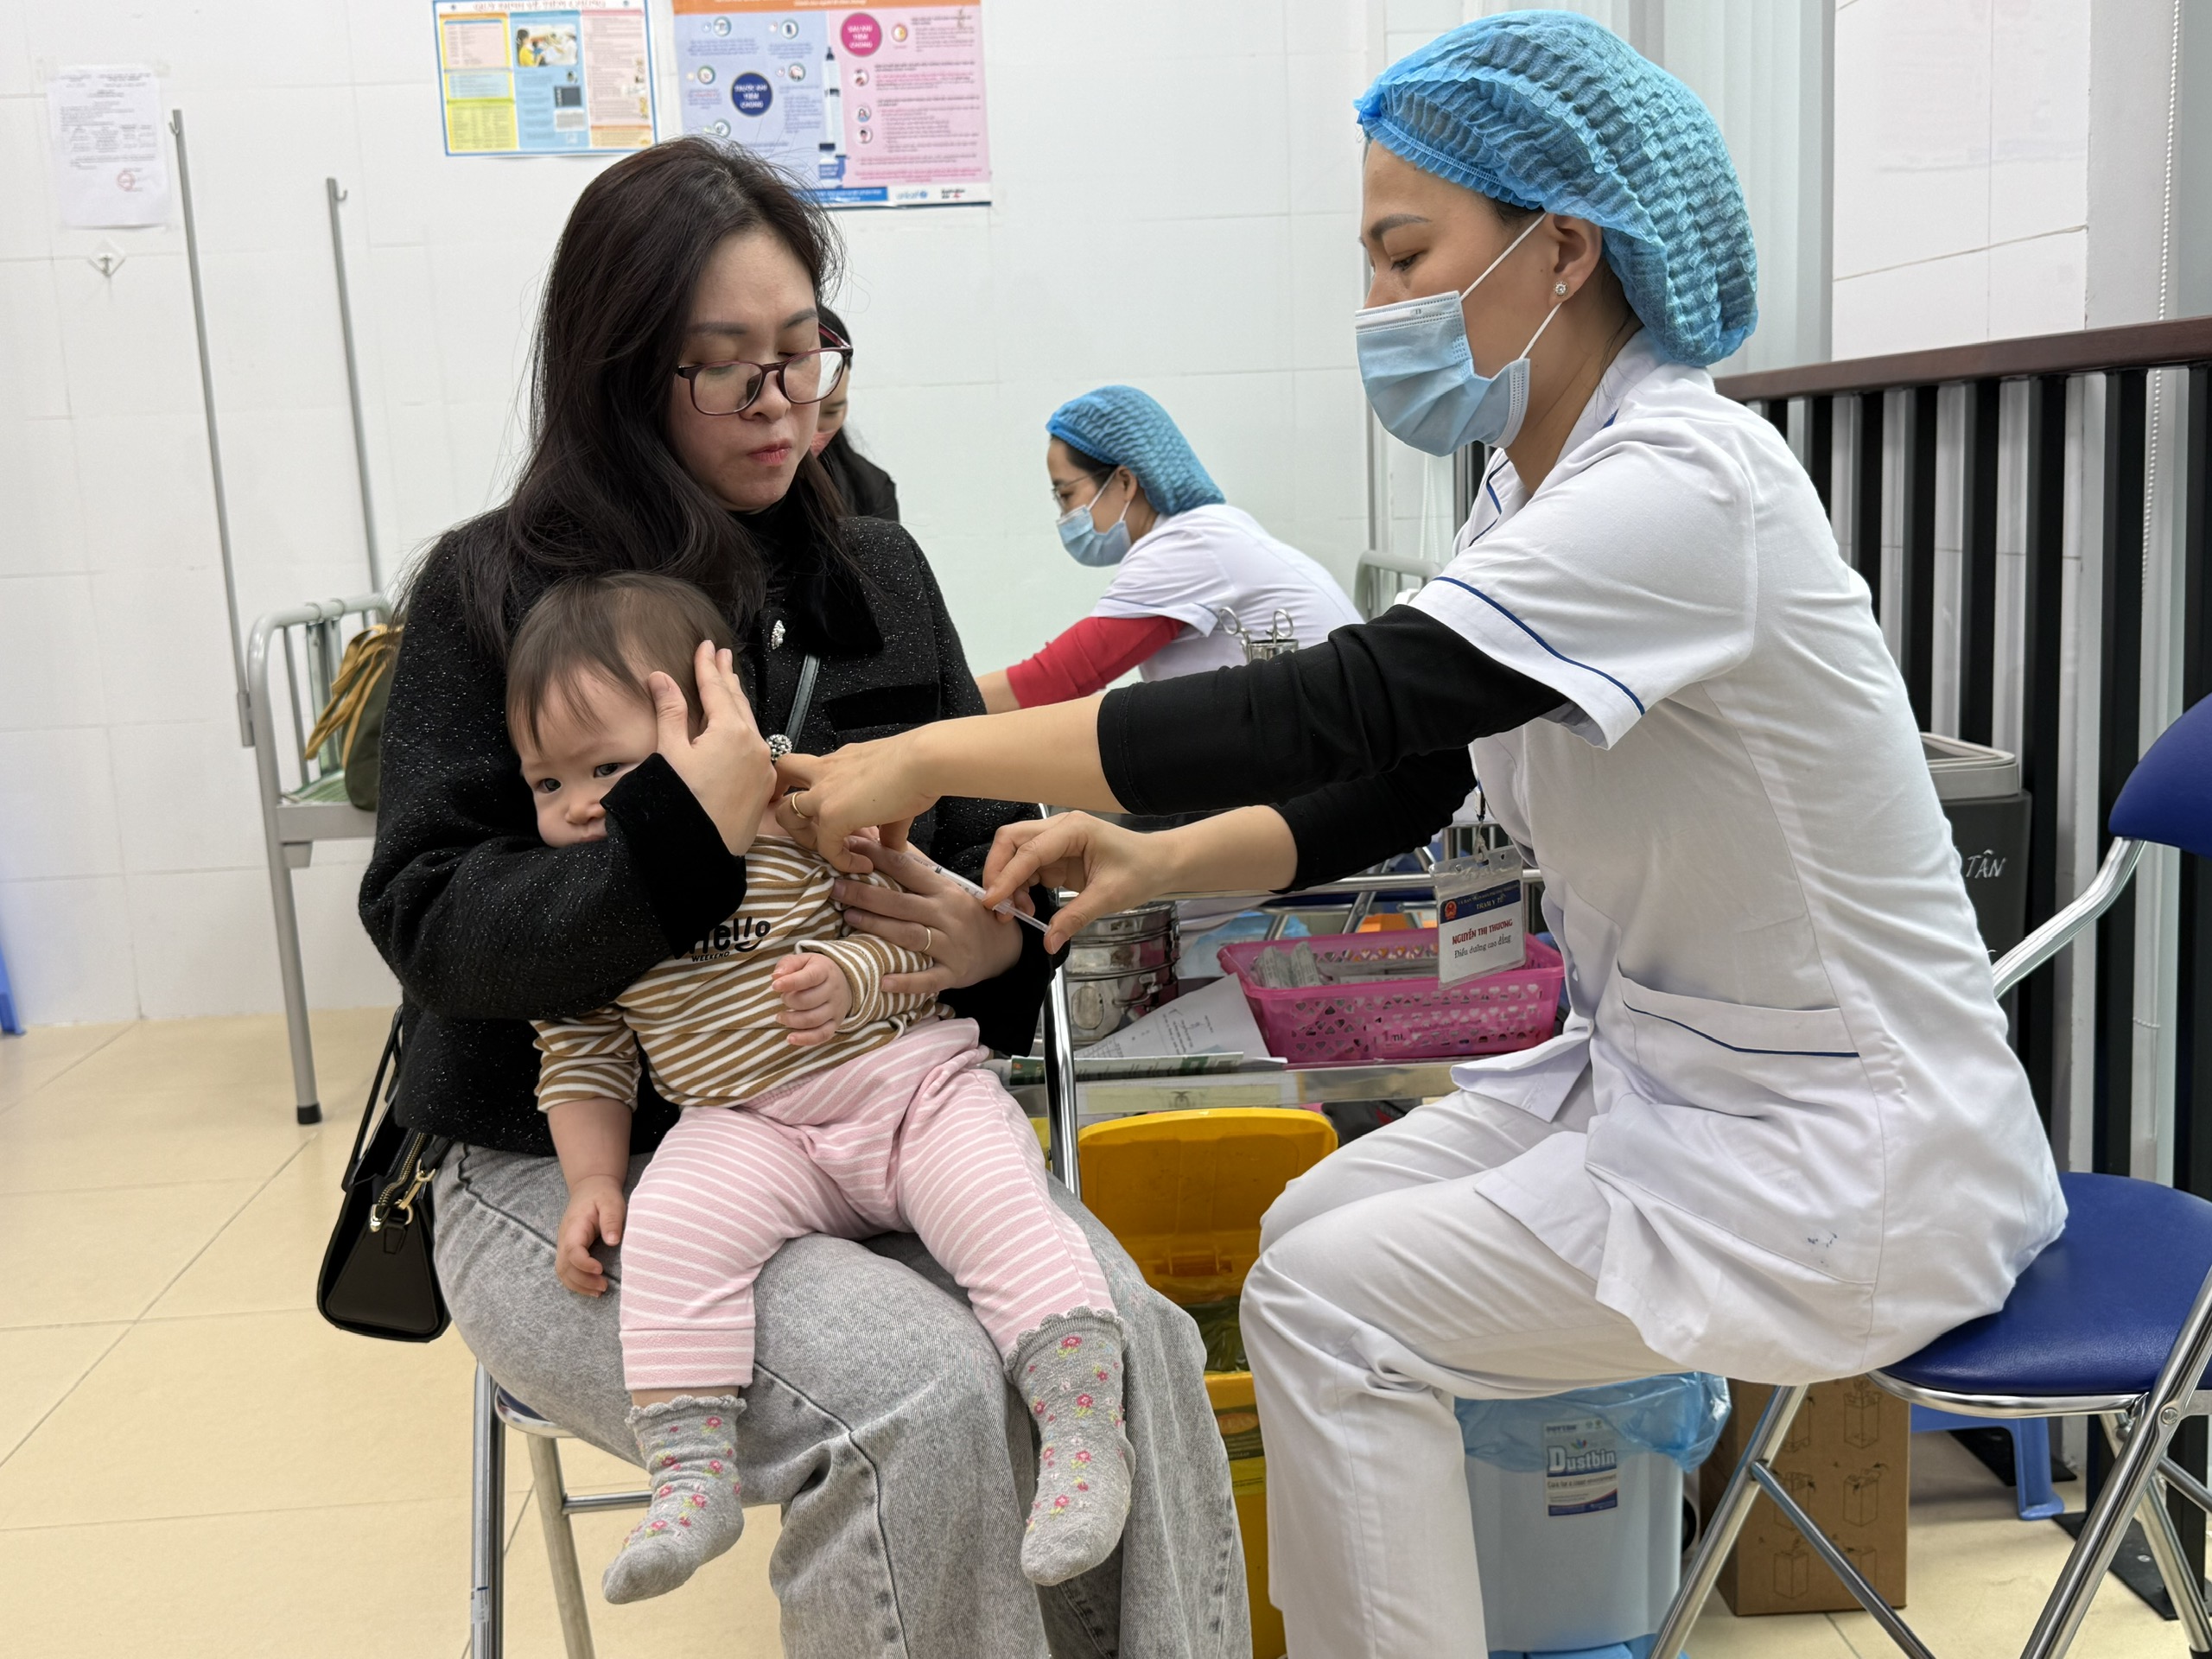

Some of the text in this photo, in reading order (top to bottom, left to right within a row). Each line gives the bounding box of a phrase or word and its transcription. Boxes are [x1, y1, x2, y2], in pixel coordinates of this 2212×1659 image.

[1966, 849, 2007, 879] TÂN
[691, 951, 730, 963] WEEKEND
[1548, 1446, 1617, 1474] Dustbin
